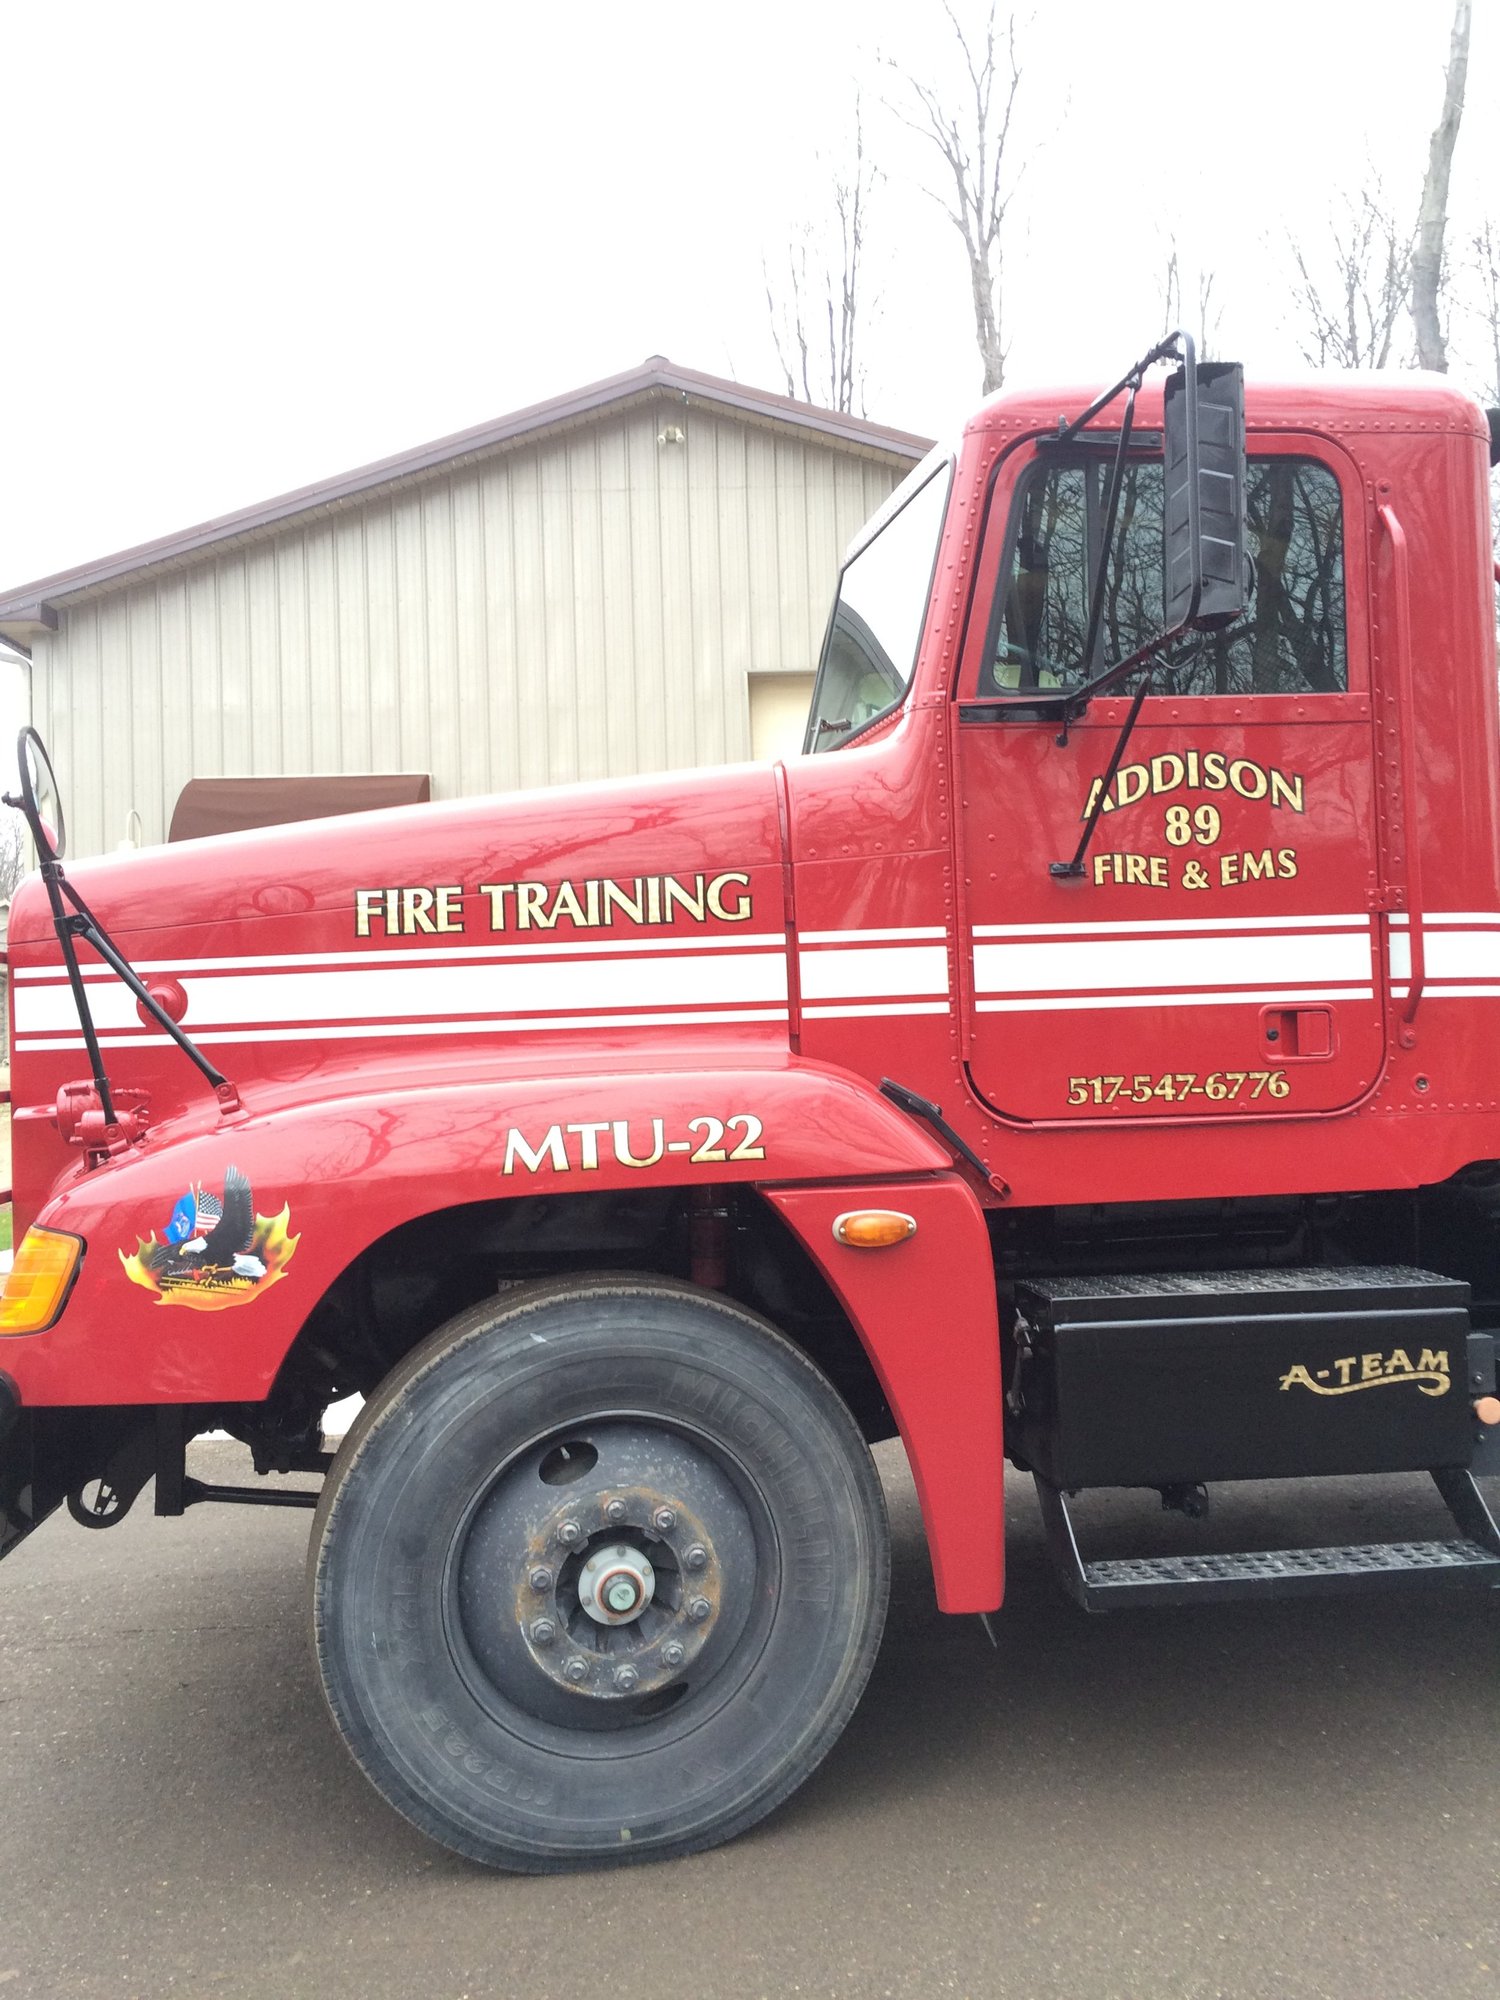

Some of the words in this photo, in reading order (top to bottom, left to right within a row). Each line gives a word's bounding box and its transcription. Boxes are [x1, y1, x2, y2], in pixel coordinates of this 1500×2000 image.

[1081, 750, 1305, 821] ADDISON
[1164, 803, 1221, 847] 89
[1093, 852, 1169, 888] FIRE
[1181, 859, 1211, 890] &
[1219, 848, 1298, 887] EMS
[355, 886, 464, 937] FIRE
[480, 872, 752, 931] TRAINING
[1067, 1070, 1291, 1106] 517-547-6776
[502, 1114, 766, 1175] MTU-22
[1278, 1347, 1452, 1398] A-TEAM
[667, 1366, 834, 1603] MICHELIN
